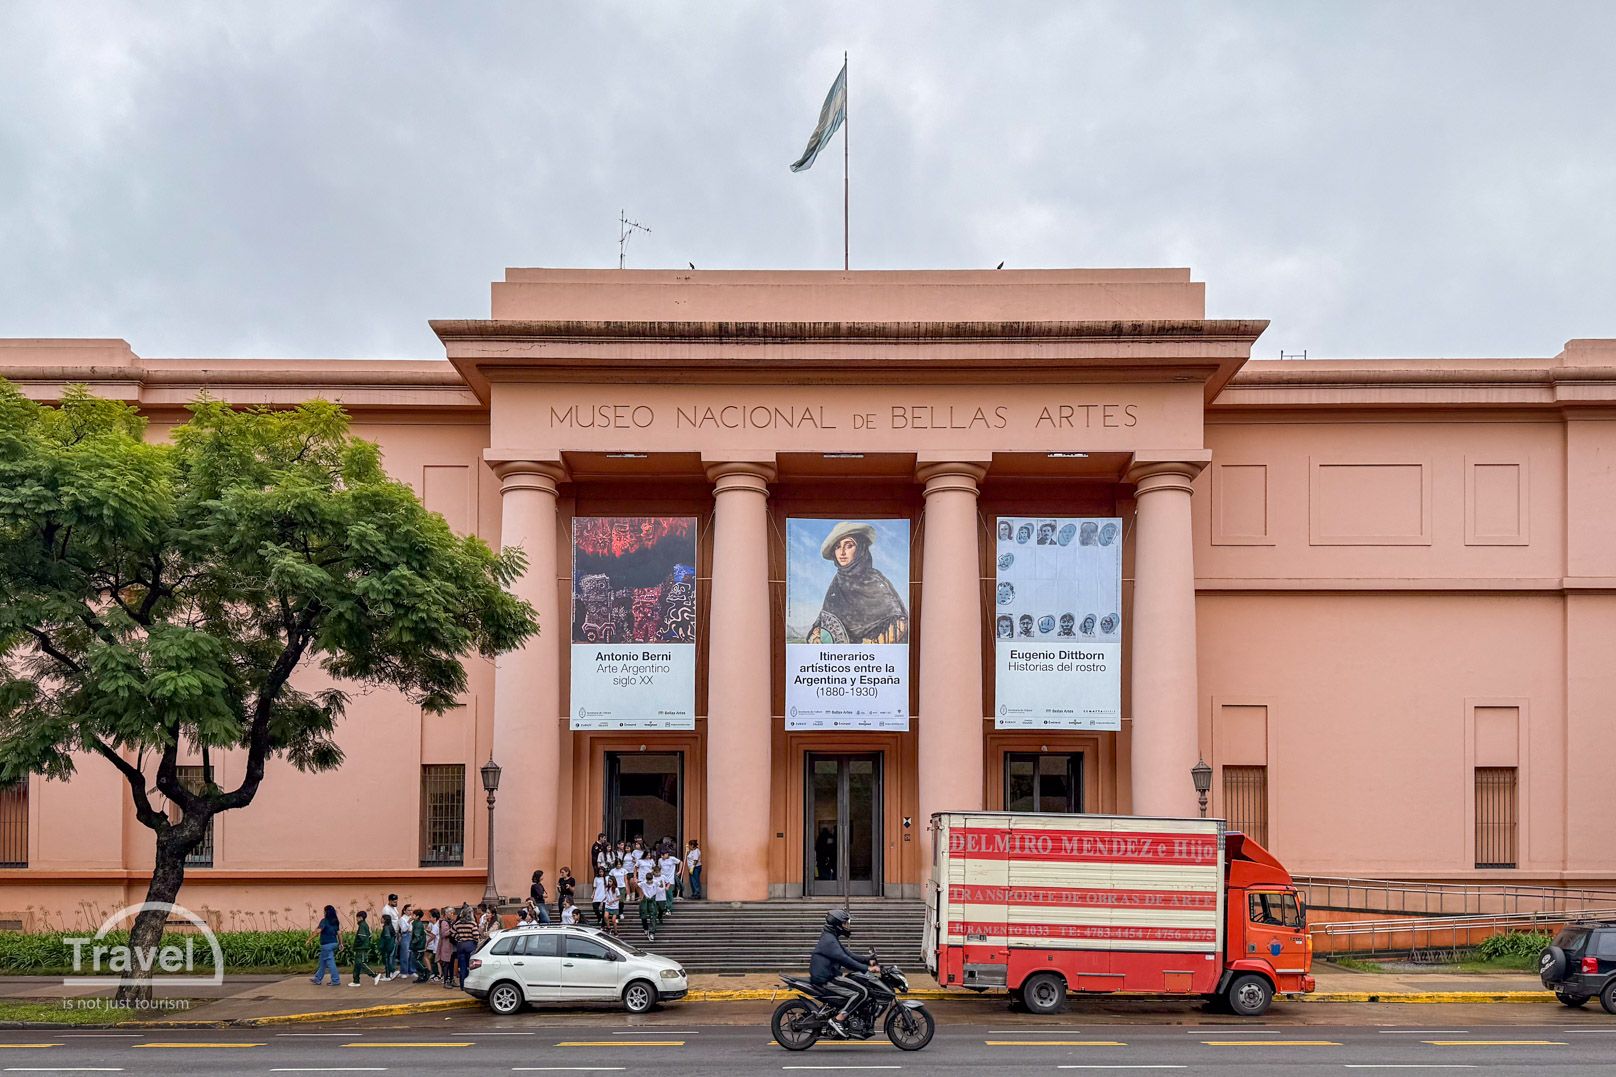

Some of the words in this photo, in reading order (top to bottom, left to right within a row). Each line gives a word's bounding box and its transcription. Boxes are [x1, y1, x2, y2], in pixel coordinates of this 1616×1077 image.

[550, 405, 655, 429] MUSEO
[676, 405, 837, 429] NACIONAL
[852, 413, 877, 430] DE
[890, 405, 1008, 429] BELLAS
[1035, 404, 1138, 428] ARTES
[595, 651, 639, 661] Antonio
[642, 651, 671, 661] Berni
[819, 651, 875, 661] Itinerarios
[1010, 650, 1056, 662] Eugenio
[1058, 650, 1105, 661] Dittborn
[596, 663, 618, 674] Arte
[620, 663, 670, 676] Argentino
[799, 662, 851, 673] artísticos
[853, 664, 882, 673] entre
[885, 663, 895, 673] la
[1008, 661, 1054, 672] Historias
[1056, 661, 1073, 672] del
[1075, 662, 1107, 672] rostro
[612, 675, 637, 688] siglo
[639, 675, 654, 686] XX
[793, 675, 847, 687] Argentina
[849, 677, 857, 687] y
[859, 674, 900, 687] España
[816, 686, 878, 699] (1880-1930)
[950, 833, 1053, 855] DELMIRO
[1061, 836, 1153, 858] MENDEZ
[1157, 842, 1167, 858] e
[1172, 838, 1214, 863] Hijo
[952, 887, 1056, 903] TRANSPORTE
[1062, 892, 1082, 904] DE
[1085, 893, 1140, 905] OBRAS
[1144, 895, 1164, 906] DE
[1170, 896, 1213, 907] ARTE
[952, 923, 1023, 935] JURAMENTO
[1145, 928, 1152, 939] /
